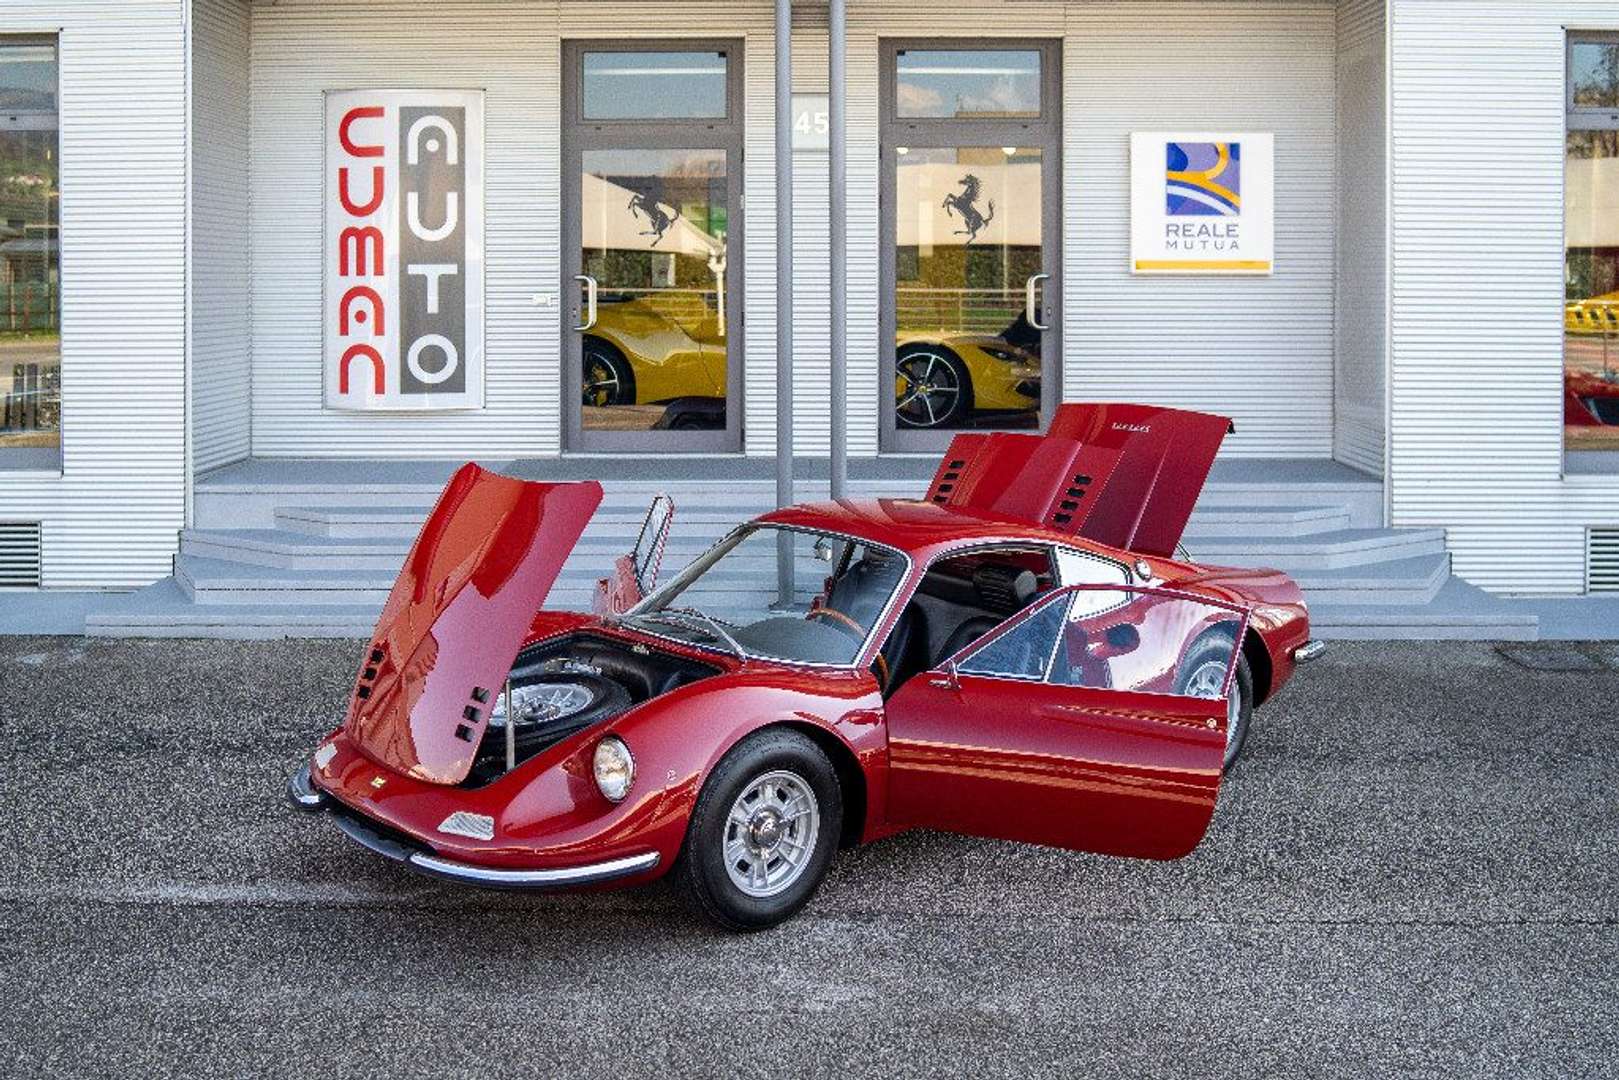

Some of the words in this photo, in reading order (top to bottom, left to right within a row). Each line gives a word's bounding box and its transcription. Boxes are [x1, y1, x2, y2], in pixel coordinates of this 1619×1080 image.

[793, 111, 829, 135] 45
[1165, 223, 1240, 238] REALE
[338, 106, 385, 395] CUMAN
[407, 115, 458, 384] AUTO
[1165, 240, 1240, 251] MUTUA
